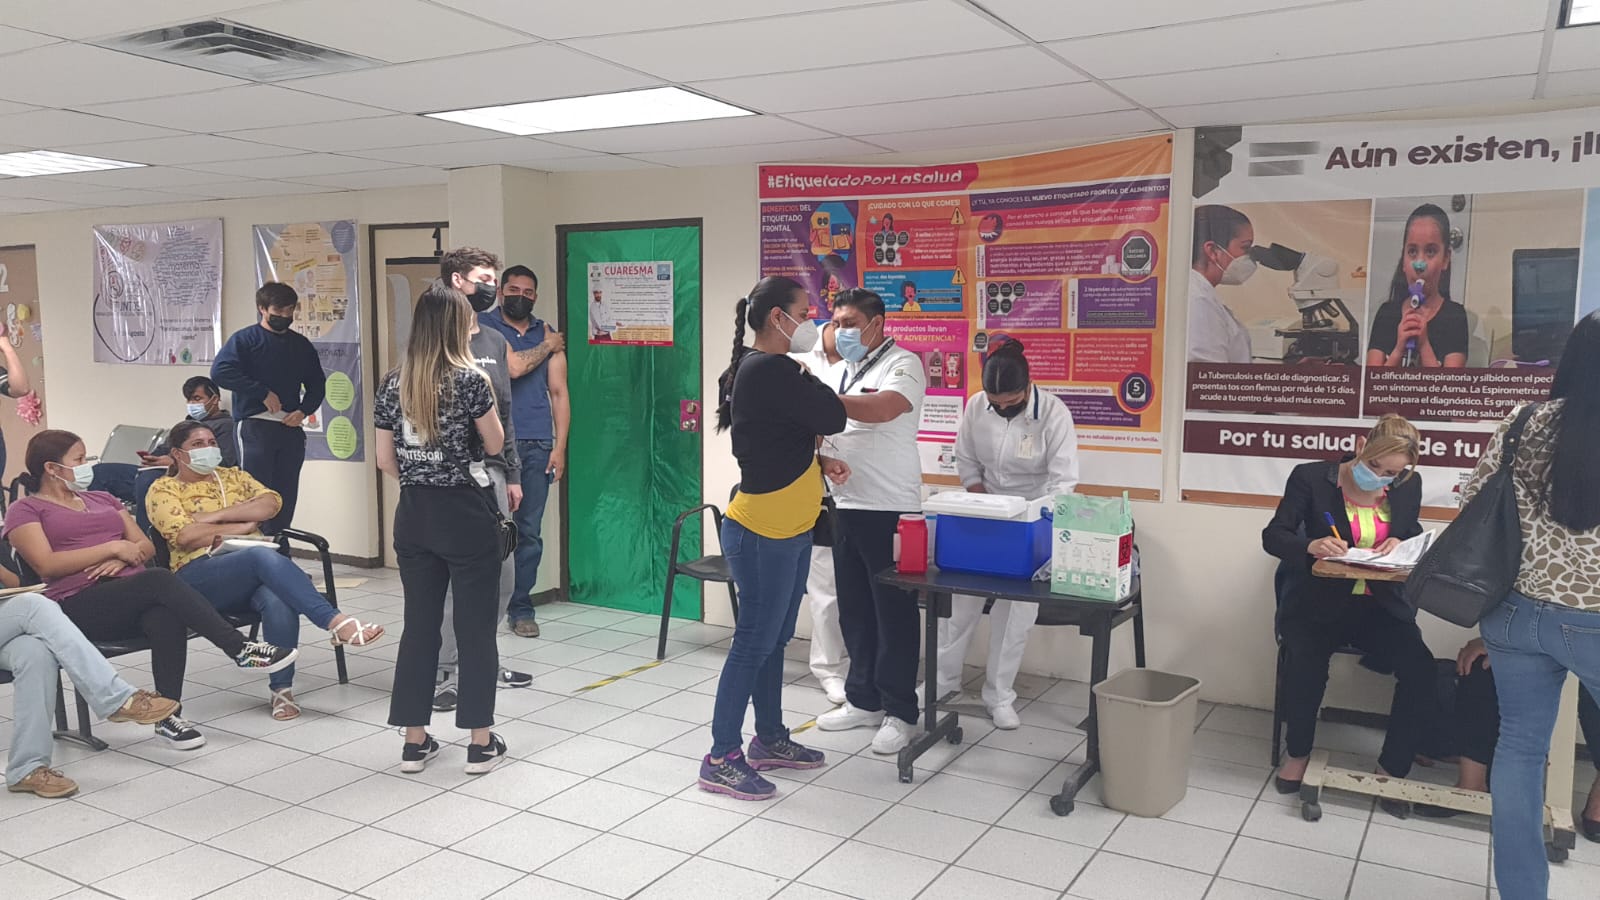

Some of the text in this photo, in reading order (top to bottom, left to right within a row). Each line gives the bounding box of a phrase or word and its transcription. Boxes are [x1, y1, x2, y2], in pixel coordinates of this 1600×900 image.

[1325, 141, 1398, 170] Aún
[1408, 135, 1560, 165] existen,
[767, 169, 962, 191] #EtiquetadoPorLaSalud
[996, 196, 1023, 204] CONOCES
[1032, 193, 1053, 201] NUEVO
[1053, 190, 1089, 200] ETIQUETADO
[1090, 187, 1118, 196] FRONTAL
[1119, 186, 1128, 194] DE
[762, 204, 812, 213] BENEFICIOS DEL
[897, 201, 911, 209] CON
[912, 201, 921, 209] LO
[921, 200, 935, 209] QUE
[762, 214, 803, 223] ETIQUETADO
[762, 224, 792, 233] FRONTAL
[604, 264, 654, 276] CUARESMA
[892, 324, 926, 333] productos
[927, 324, 948, 332] llevan
[903, 334, 956, 342] ADVERTENCIA?
[1198, 371, 1208, 379] La
[1208, 371, 1254, 381] Tuberculosis
[1263, 372, 1280, 381] fácil
[1280, 373, 1290, 382] de
[1291, 373, 1342, 384] diagnosticar.
[1341, 374, 1350, 383] Si
[1370, 371, 1554, 384] La dificultad respiratoria y silbido en el pec
[1132, 381, 1141, 392] 5
[1192, 382, 1227, 391] presentas
[1227, 382, 1240, 391] tos
[1281, 385, 1297, 394] por
[1296, 384, 1313, 393] más
[1313, 385, 1325, 394] de
[1326, 385, 1336, 394] 15
[1372, 384, 1388, 392] son
[1389, 383, 1428, 392] síntomas
[1428, 384, 1440, 393] de
[1441, 385, 1469, 394] Asma.
[1469, 385, 1481, 394] La
[1481, 385, 1540, 396] Espirometría
[1199, 393, 1222, 401] acude
[1228, 394, 1237, 402] tu
[1237, 394, 1262, 402] centro
[1262, 394, 1273, 403] de
[1273, 394, 1295, 404] salud
[1295, 395, 1312, 404] más
[1369, 394, 1400, 404] prueba
[1400, 396, 1420, 405] para
[1420, 395, 1429, 404] el
[1430, 395, 1483, 407] diagnóstico.
[1483, 398, 1495, 407] Es
[1425, 408, 1437, 416] tu
[1437, 408, 1465, 417] centro
[1466, 408, 1478, 417] de
[1479, 409, 1505, 418] salud.
[1219, 429, 1356, 452] Por tu salud
[1417, 436, 1480, 457] de tu
